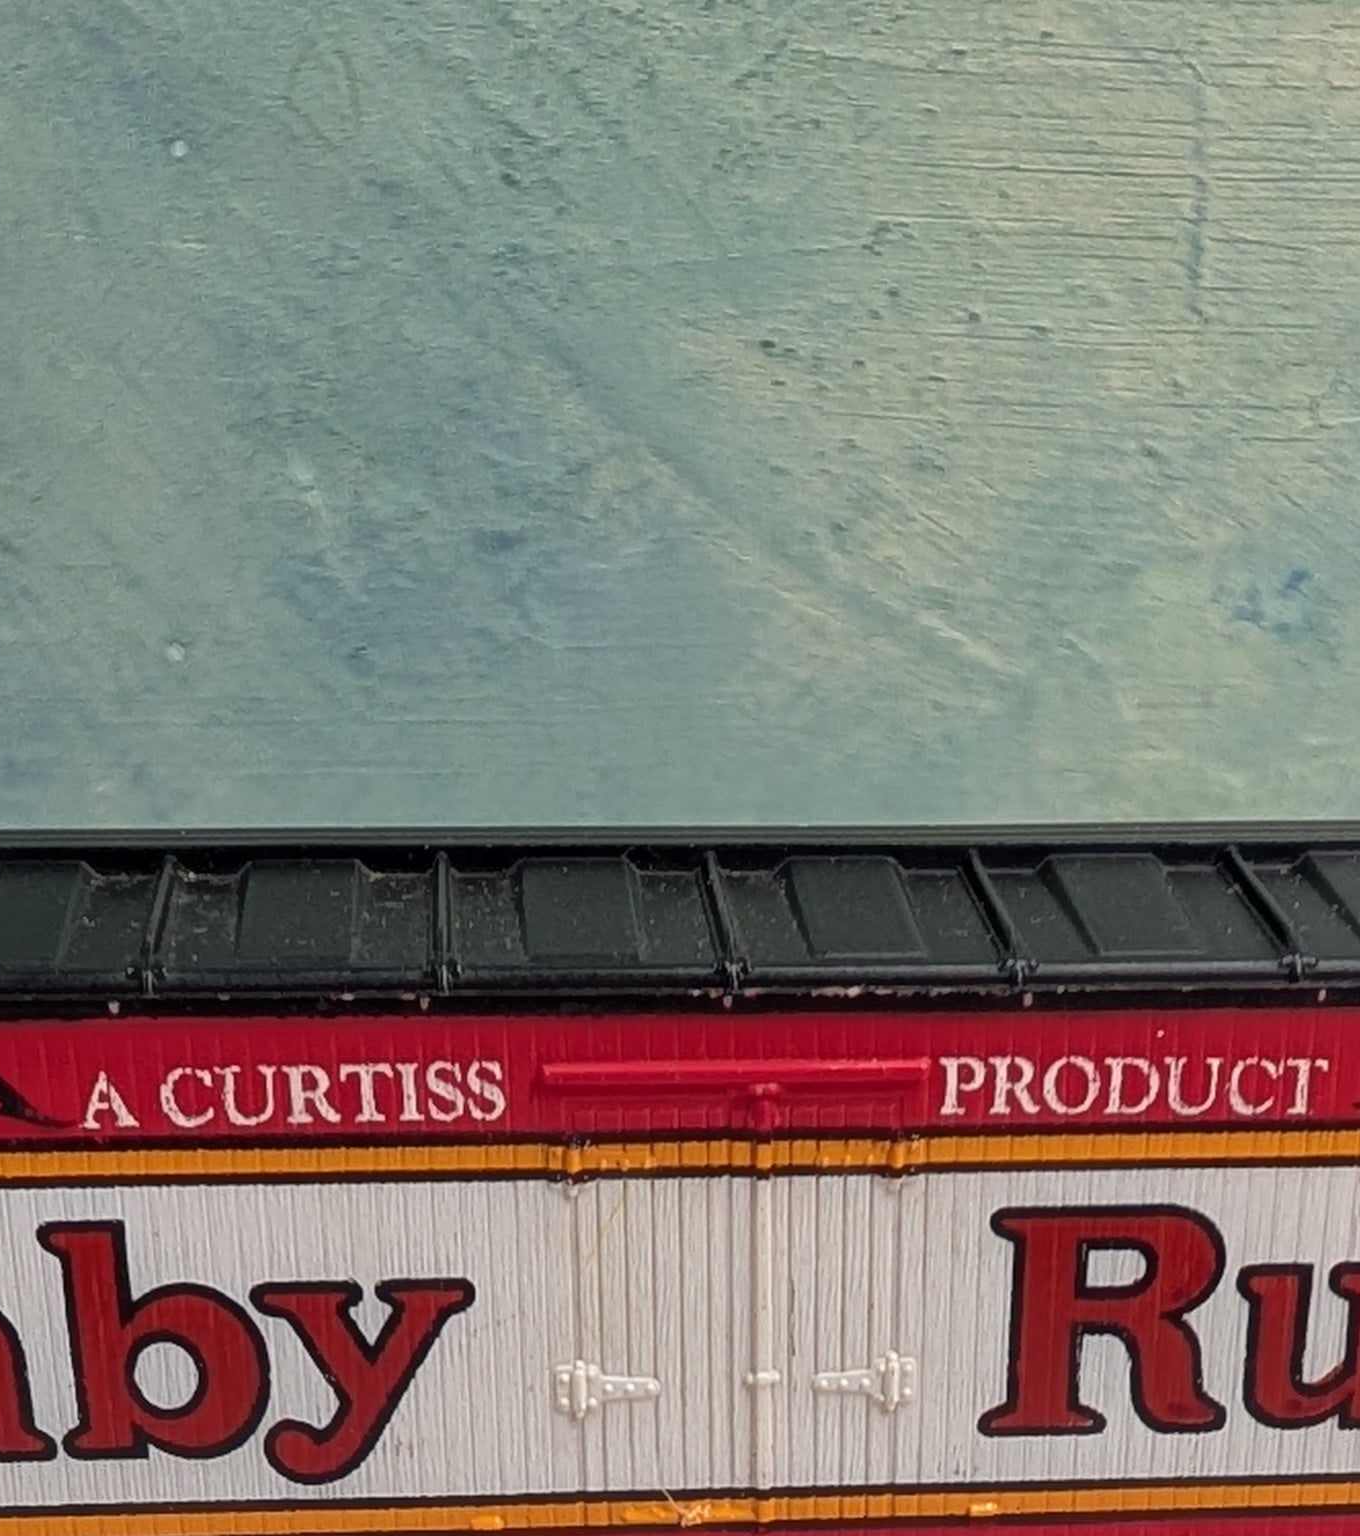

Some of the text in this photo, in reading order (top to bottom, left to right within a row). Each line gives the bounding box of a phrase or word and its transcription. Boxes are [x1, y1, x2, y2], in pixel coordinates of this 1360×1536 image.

[81, 1055, 1330, 1130] A CURTISS PRODUCT
